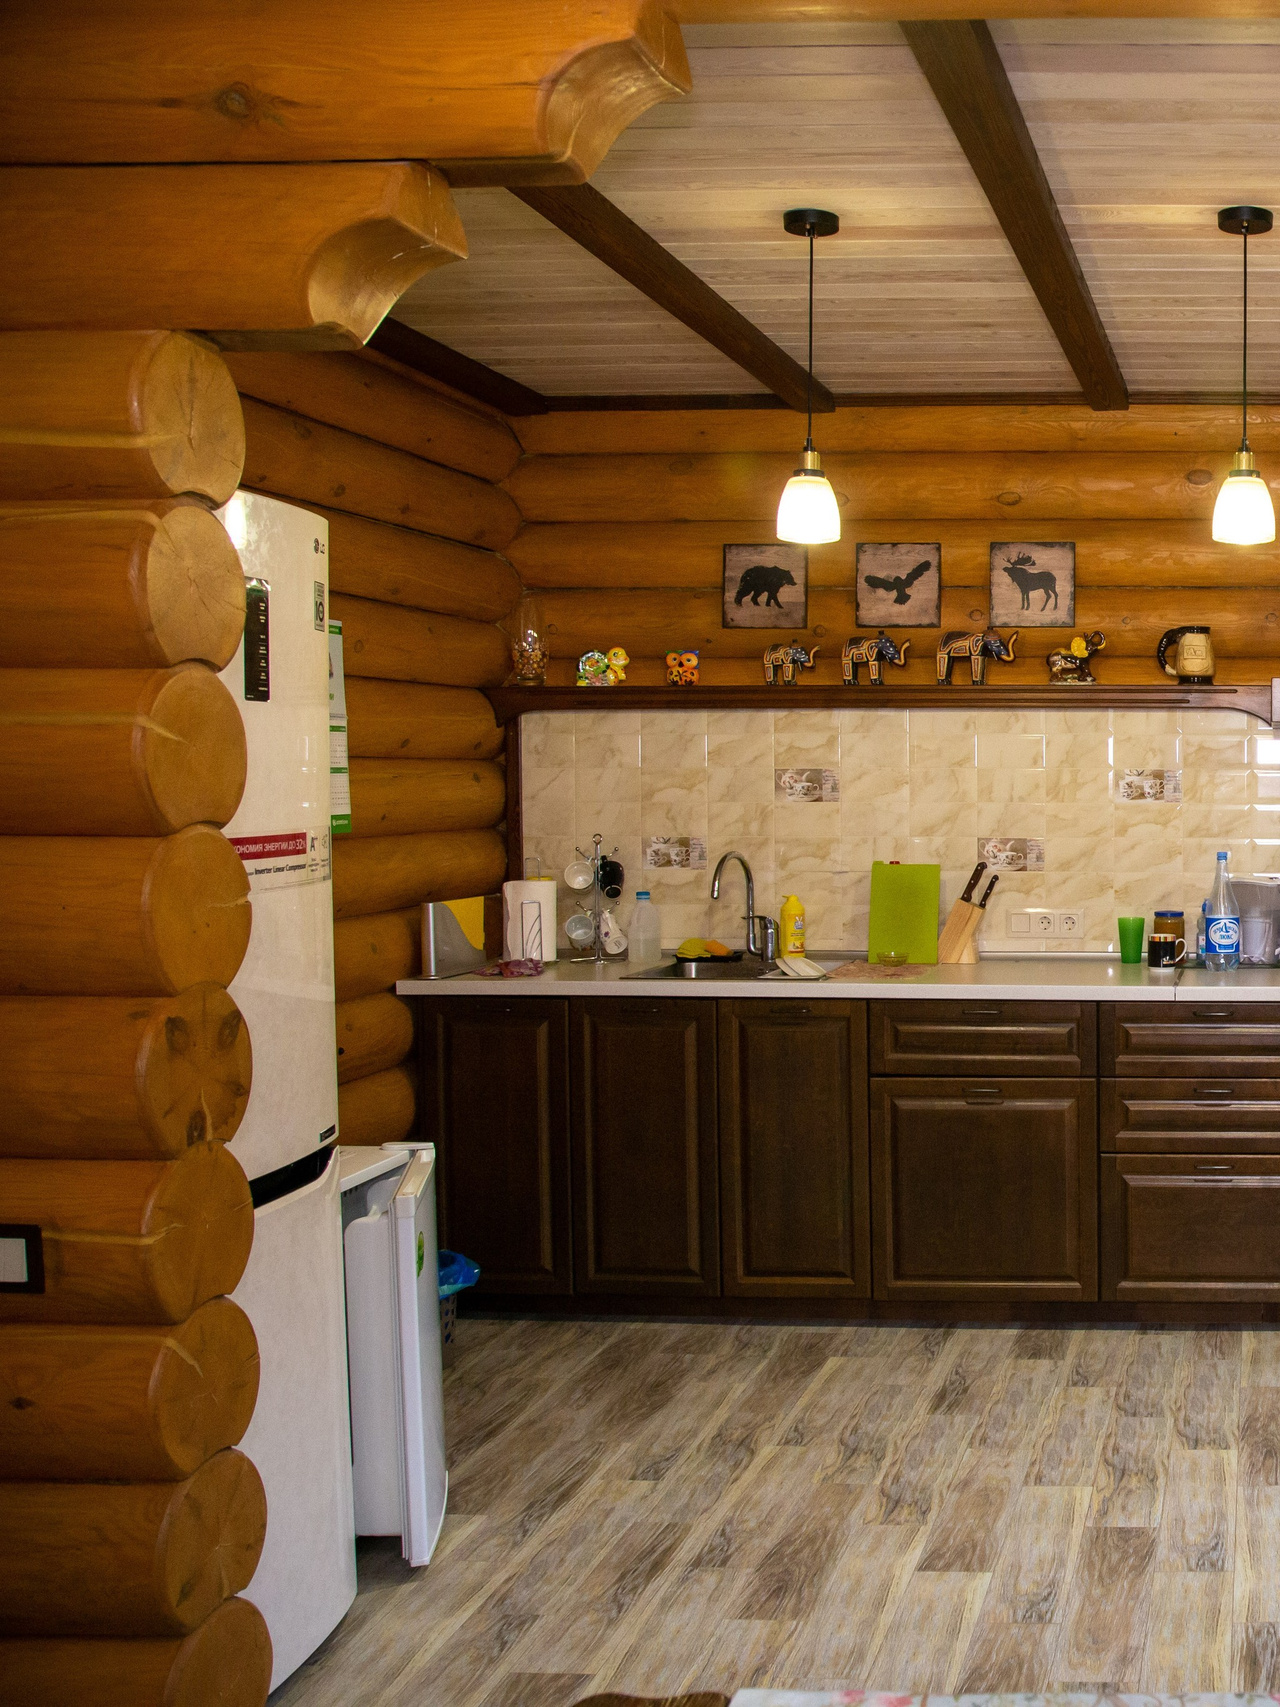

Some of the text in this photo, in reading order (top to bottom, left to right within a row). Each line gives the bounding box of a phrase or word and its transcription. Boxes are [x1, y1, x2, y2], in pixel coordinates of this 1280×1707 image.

[264, 841, 288, 852] ЭНЕРГИИ
[255, 867, 272, 875] Inverter
[272, 865, 285, 873] Linear
